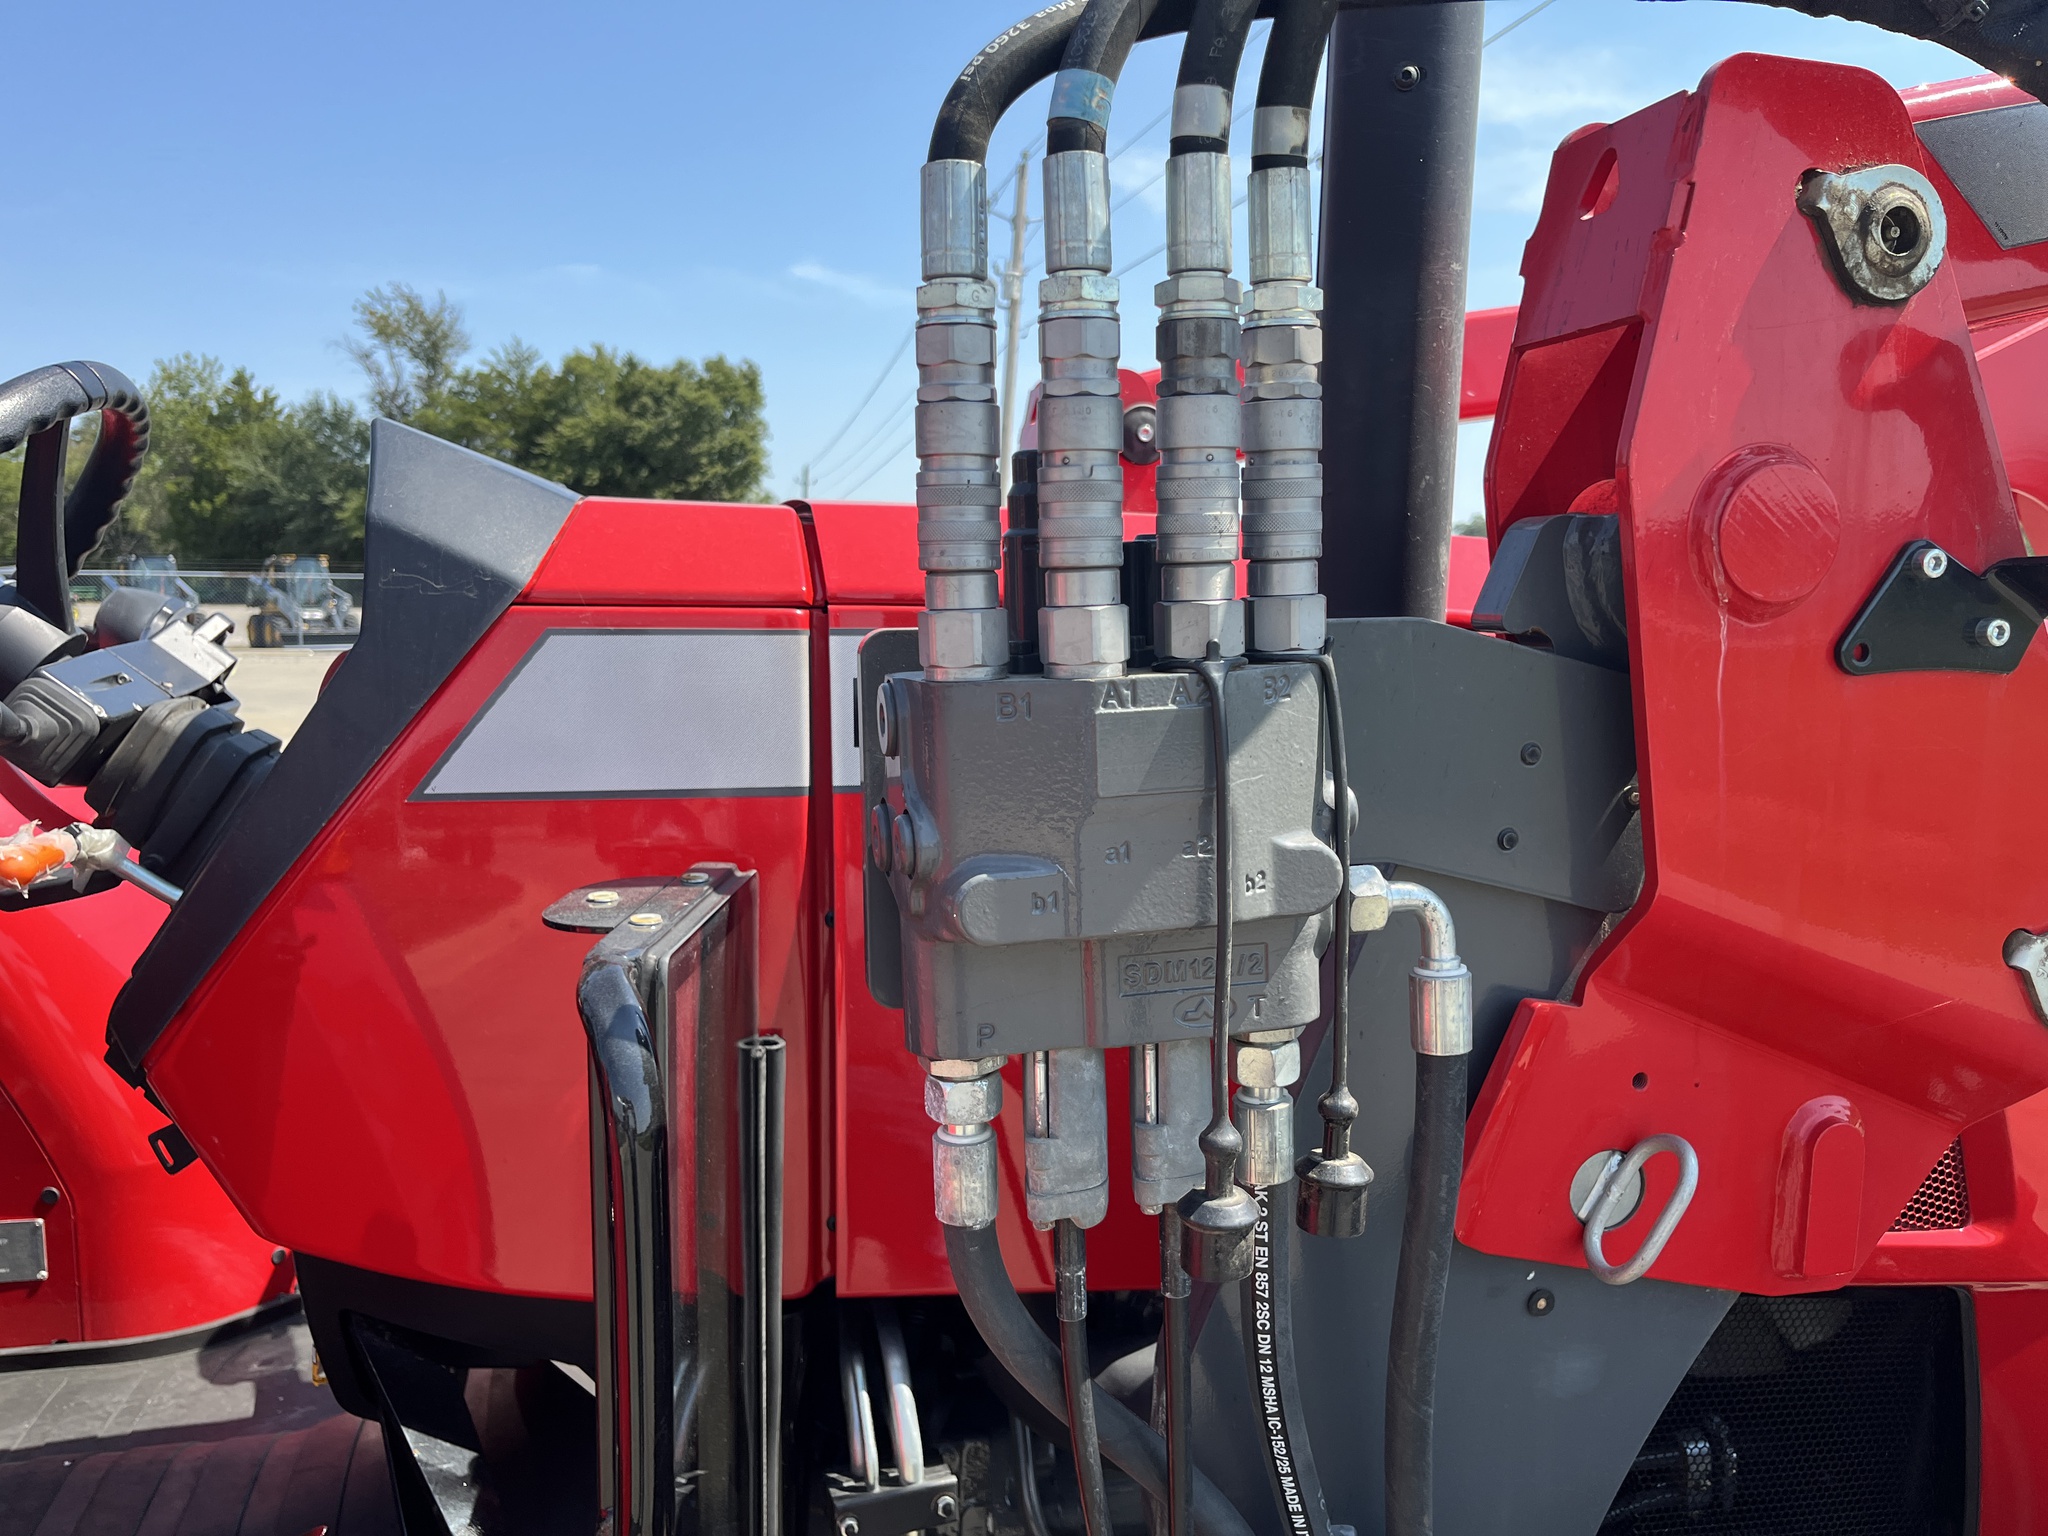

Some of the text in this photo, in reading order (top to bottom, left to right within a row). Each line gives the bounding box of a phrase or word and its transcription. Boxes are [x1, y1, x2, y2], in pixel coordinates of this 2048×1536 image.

[985, 20, 1031, 54] 3260
[960, 55, 985, 82] psi
[1099, 679, 1138, 709] A1
[1262, 674, 1292, 705] B2
[995, 692, 1033, 722] B1
[1104, 840, 1131, 865] a1
[1181, 834, 1215, 859] a2
[1245, 870, 1266, 896] b2
[1031, 890, 1059, 916] b1
[1123, 952, 1264, 987] SDM12/2
[1248, 994, 1267, 1018] T
[977, 1023, 995, 1047] P
[1254, 1221, 1269, 1243] ST
[1255, 1246, 1269, 1268] EN
[1255, 1272, 1270, 1299] 857
[1256, 1301, 1271, 1331] 2SC
[1257, 1333, 1272, 1355] DN
[1259, 1358, 1274, 1373] 12
[1261, 1376, 1279, 1414] MSHA
[1267, 1416, 1292, 1474] IC-152/25
[1280, 1476, 1302, 1512] MADE
[1290, 1514, 1307, 1528] IN
